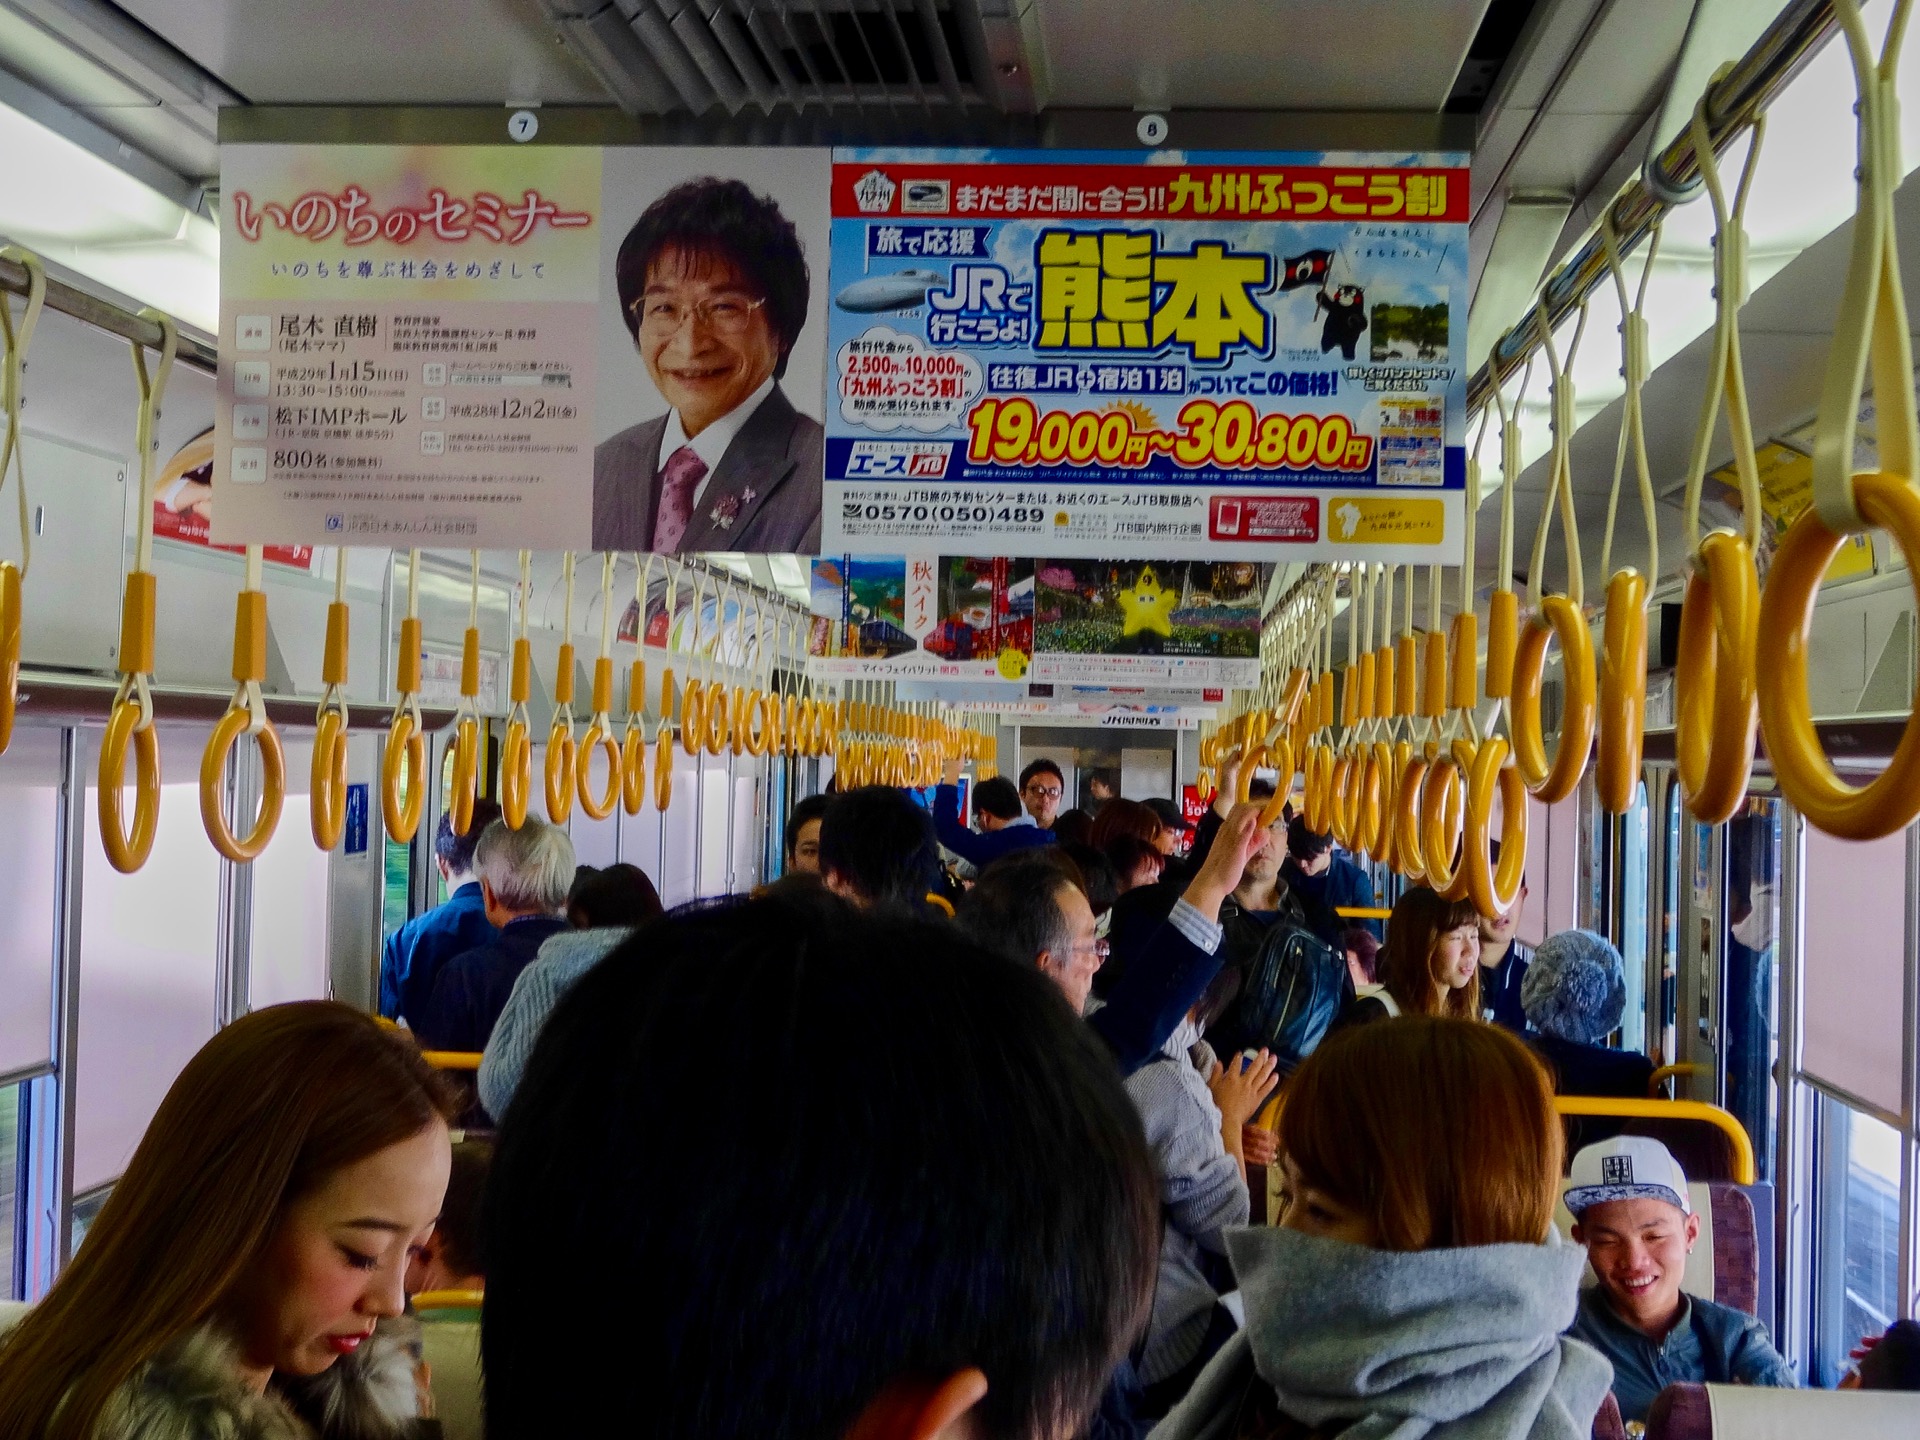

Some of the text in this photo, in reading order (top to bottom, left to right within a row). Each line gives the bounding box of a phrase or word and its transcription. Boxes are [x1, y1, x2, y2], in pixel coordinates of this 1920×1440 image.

[517, 118, 529, 134] 7
[1147, 121, 1157, 137] 8
[1167, 172, 1448, 217] 九州ふっこう割
[234, 186, 590, 246] いのちのセミナー
[876, 227, 976, 256] 旅で応援
[271, 259, 545, 279] いのちを尊ぶ社会をめざして
[930, 266, 1031, 312] JRで
[1039, 231, 1266, 360] 熊本
[279, 314, 377, 338] 尾木 直樹
[930, 313, 1030, 343] 行こうよ!
[849, 340, 915, 354] 旅行代金から
[274, 406, 408, 426] 松下IMPホール
[849, 455, 907, 474] エース
[865, 505, 1045, 524] 0570(050)489
[912, 560, 932, 630] 秋ハイク
